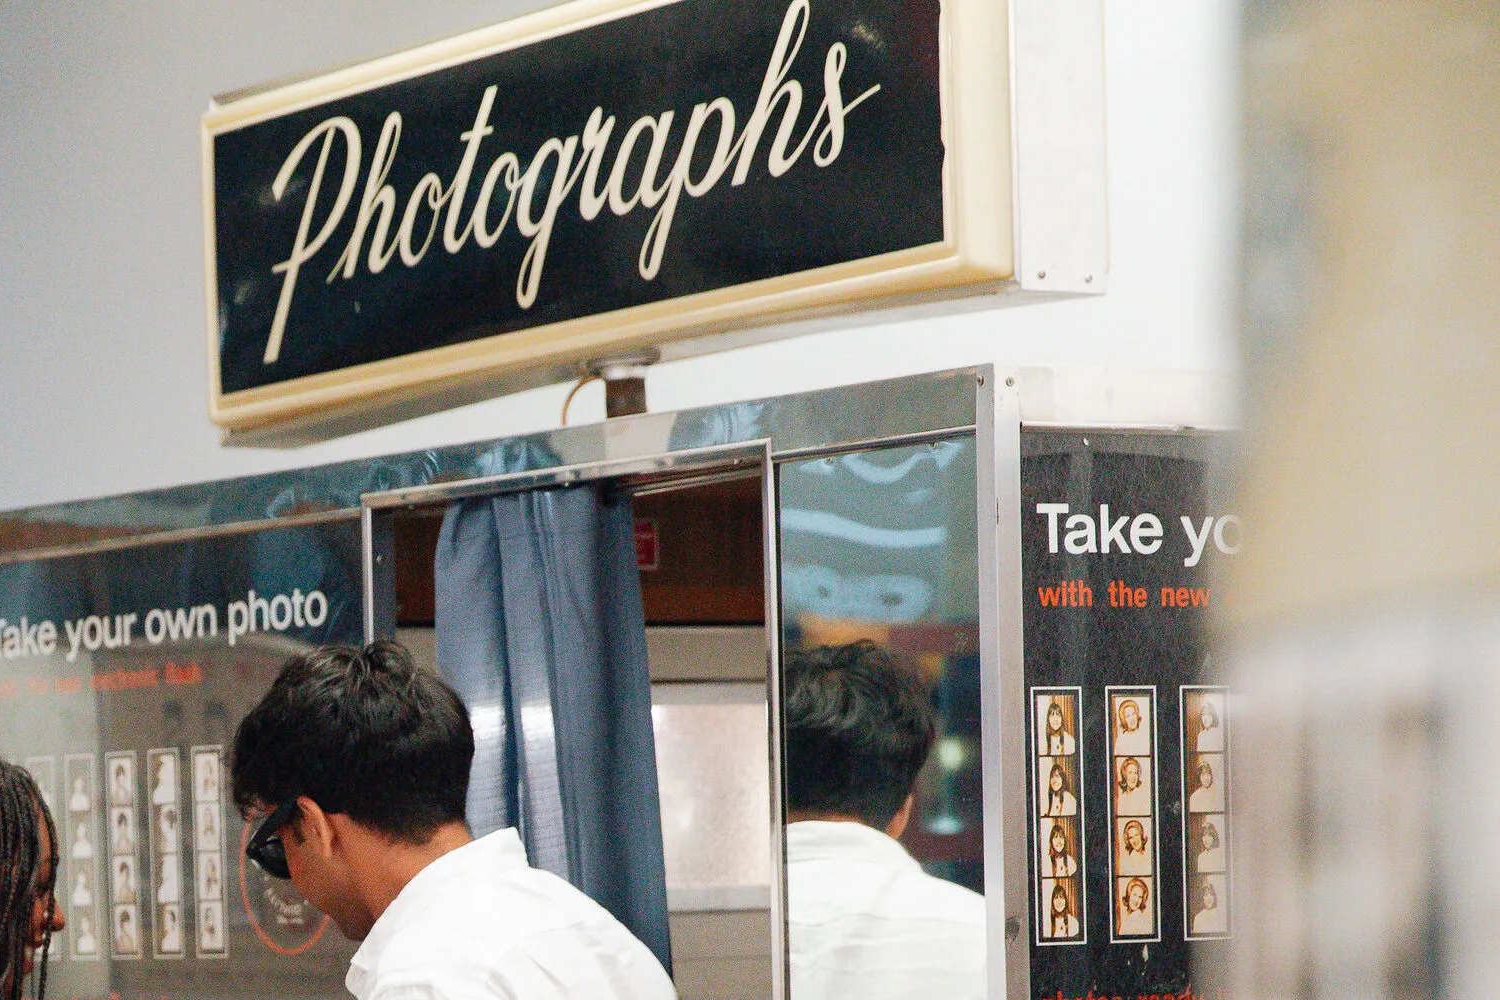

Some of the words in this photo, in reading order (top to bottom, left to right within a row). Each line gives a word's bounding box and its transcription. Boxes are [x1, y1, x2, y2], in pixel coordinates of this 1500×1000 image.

[263, 0, 881, 364] Photographs
[1036, 503, 1164, 555] Take
[1180, 514, 1245, 567] yo
[64, 612, 138, 662] your
[144, 603, 218, 645] own
[227, 588, 328, 646] photo
[1038, 578, 1093, 608] with
[1108, 579, 1148, 608] the
[1161, 585, 1212, 608] new
